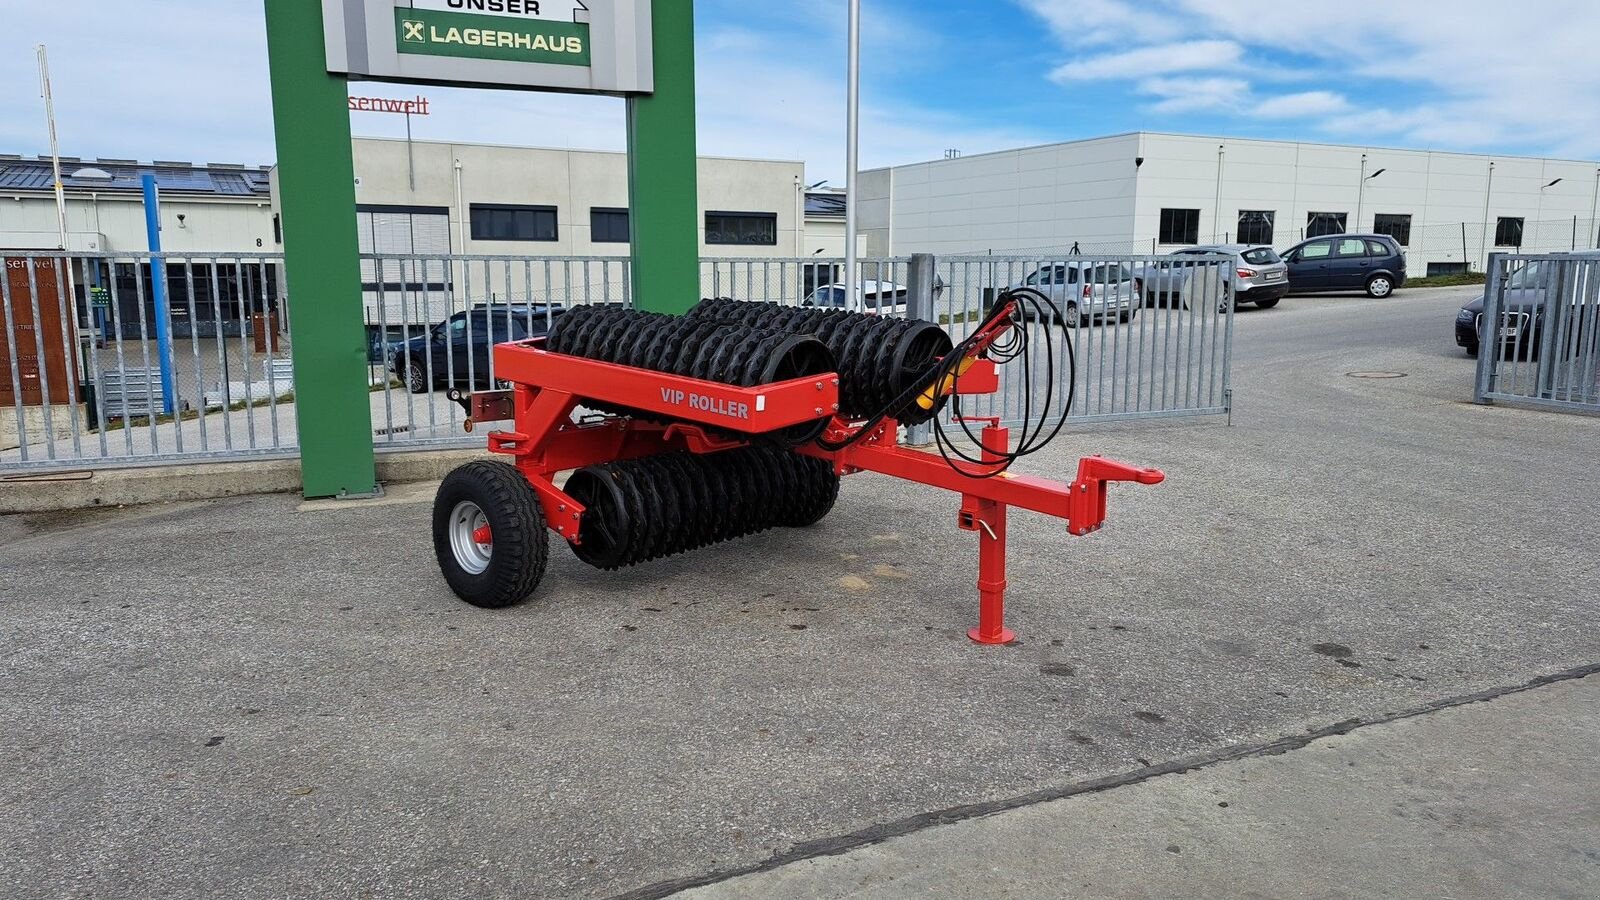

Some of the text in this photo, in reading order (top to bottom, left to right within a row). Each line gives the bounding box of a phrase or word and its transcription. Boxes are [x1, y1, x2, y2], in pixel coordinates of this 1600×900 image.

[446, 0, 541, 15] UNSER
[430, 26, 583, 55] LAGERHAUS
[347, 95, 429, 115] senwelt
[256, 237, 263, 248] 8
[660, 386, 749, 420] VIP ROLLER
